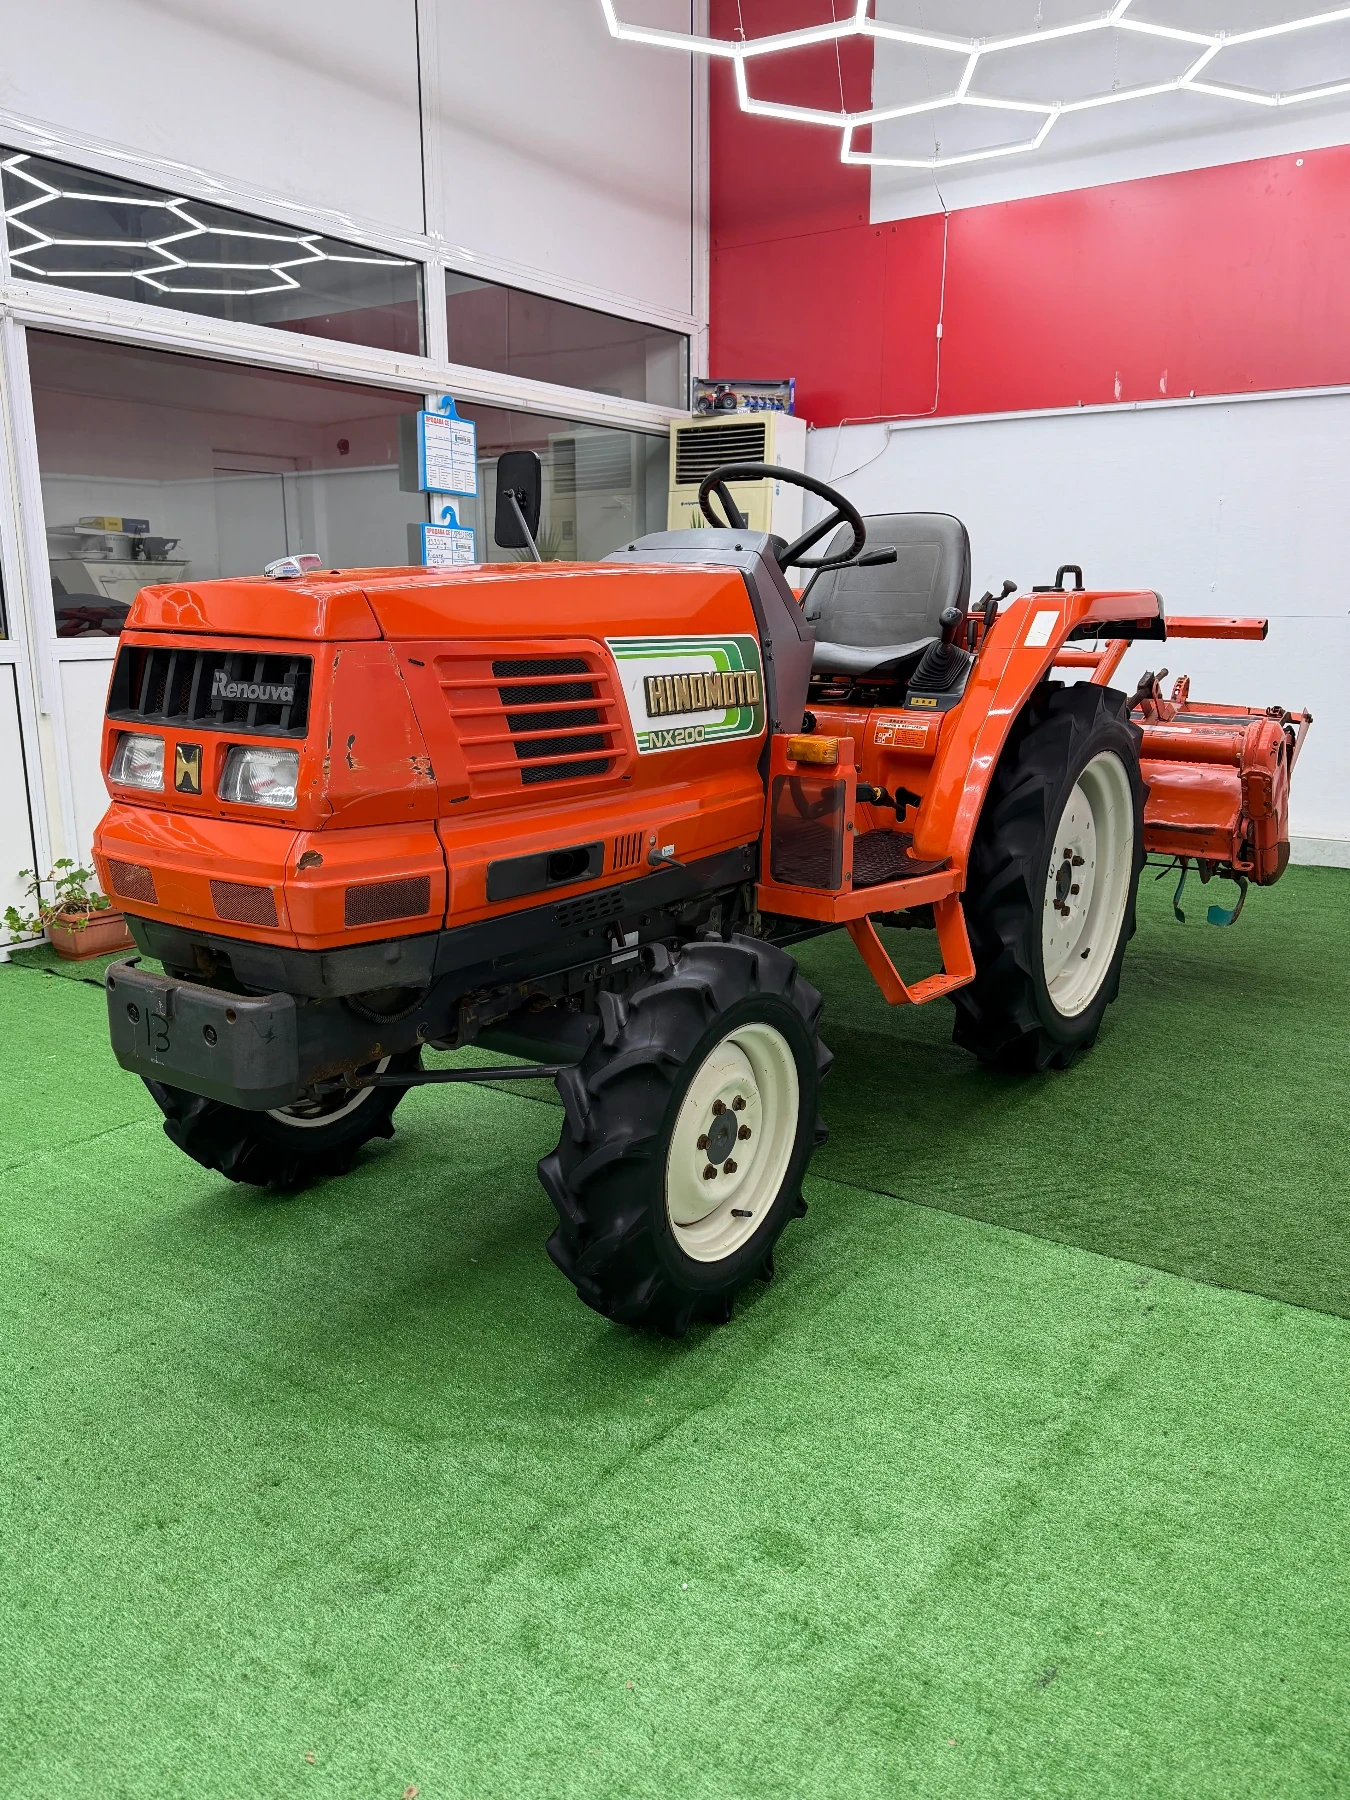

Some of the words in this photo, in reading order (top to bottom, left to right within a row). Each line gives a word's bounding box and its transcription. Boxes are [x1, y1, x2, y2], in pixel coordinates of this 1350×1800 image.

[212, 671, 294, 702] Renouva
[645, 671, 760, 717] HINOMOTO
[649, 726, 705, 749] NX200
[145, 1007, 171, 1053] 13
